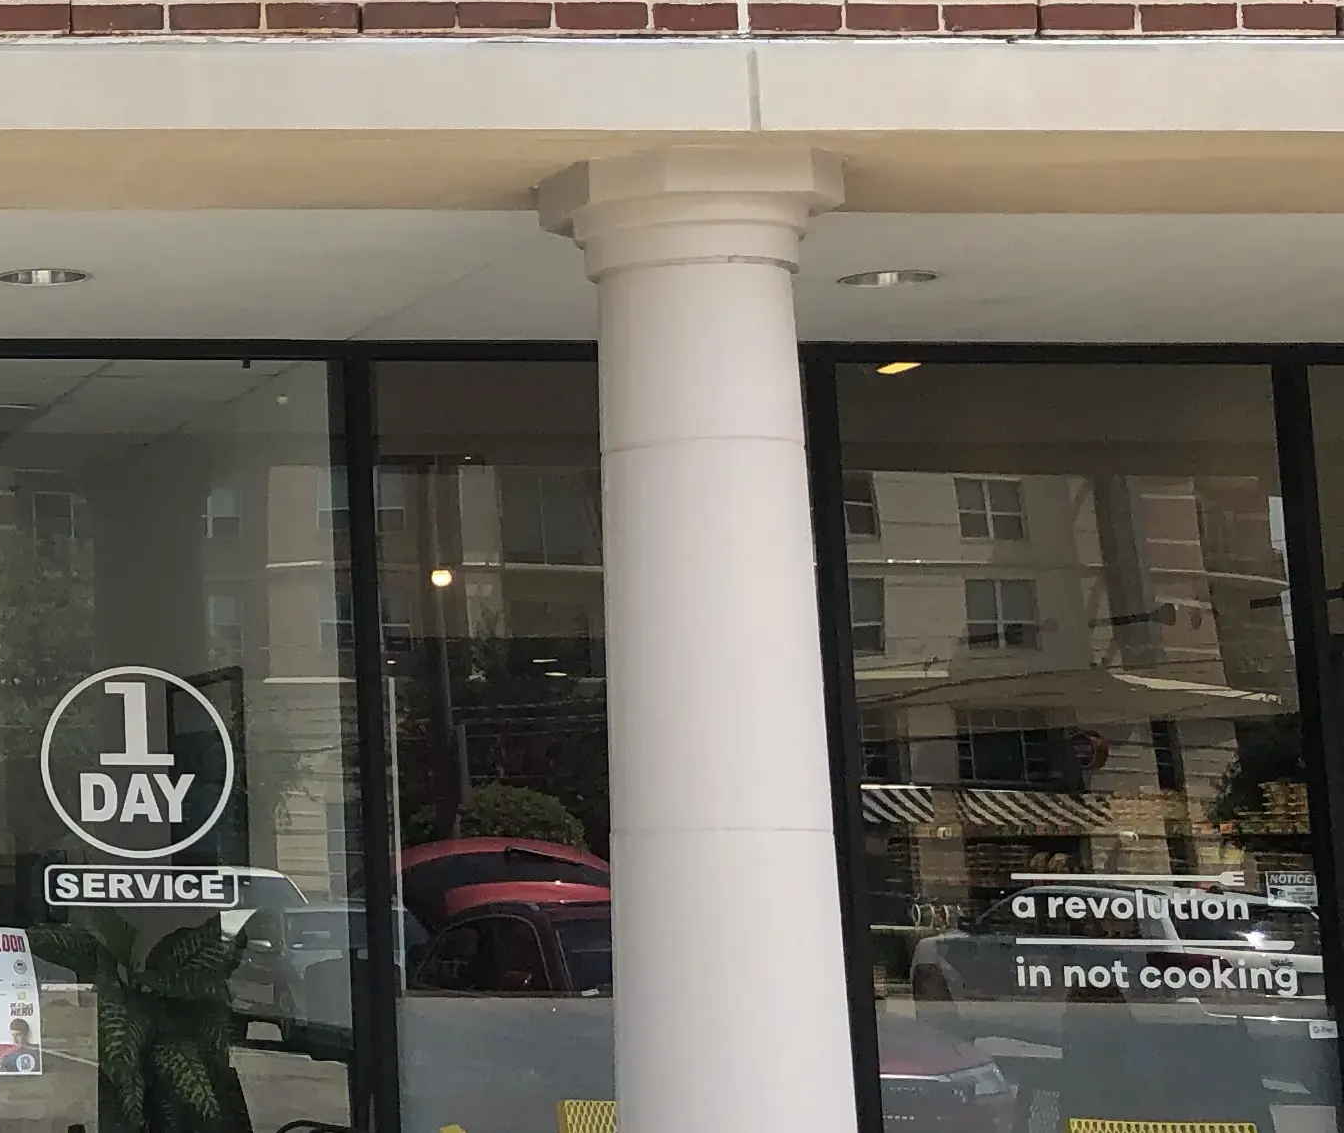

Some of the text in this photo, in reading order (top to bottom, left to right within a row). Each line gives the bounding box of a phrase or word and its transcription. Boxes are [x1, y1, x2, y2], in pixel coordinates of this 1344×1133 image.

[99, 681, 175, 766] 1
[79, 772, 196, 824] DAY
[55, 872, 225, 901] SERVICE
[1269, 873, 1314, 885] NOTICE
[1011, 889, 1250, 921] a revolution
[1015, 955, 1299, 997] in not cooking
